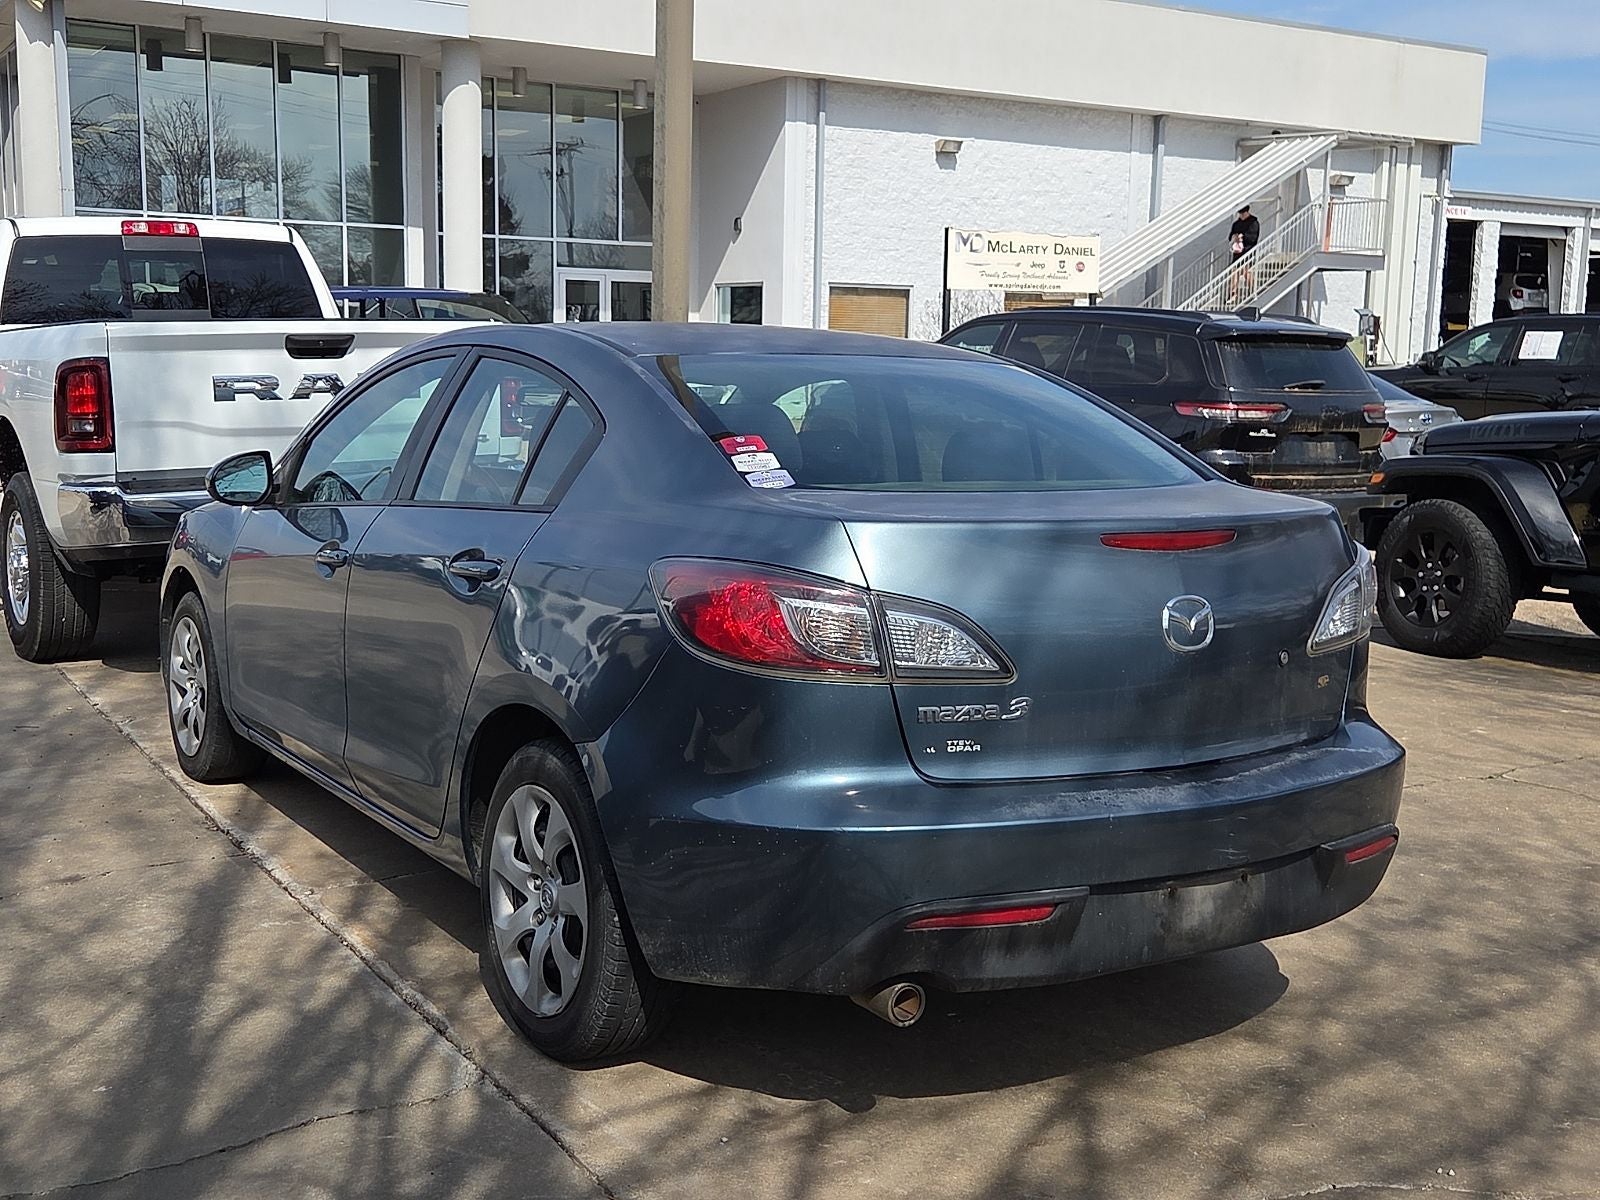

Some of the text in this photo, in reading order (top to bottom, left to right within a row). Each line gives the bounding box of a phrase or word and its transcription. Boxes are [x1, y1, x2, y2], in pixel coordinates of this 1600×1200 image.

[1030, 260, 1046, 270] Jeep
[212, 372, 347, 402] RA
[1001, 696, 1033, 721] 3
